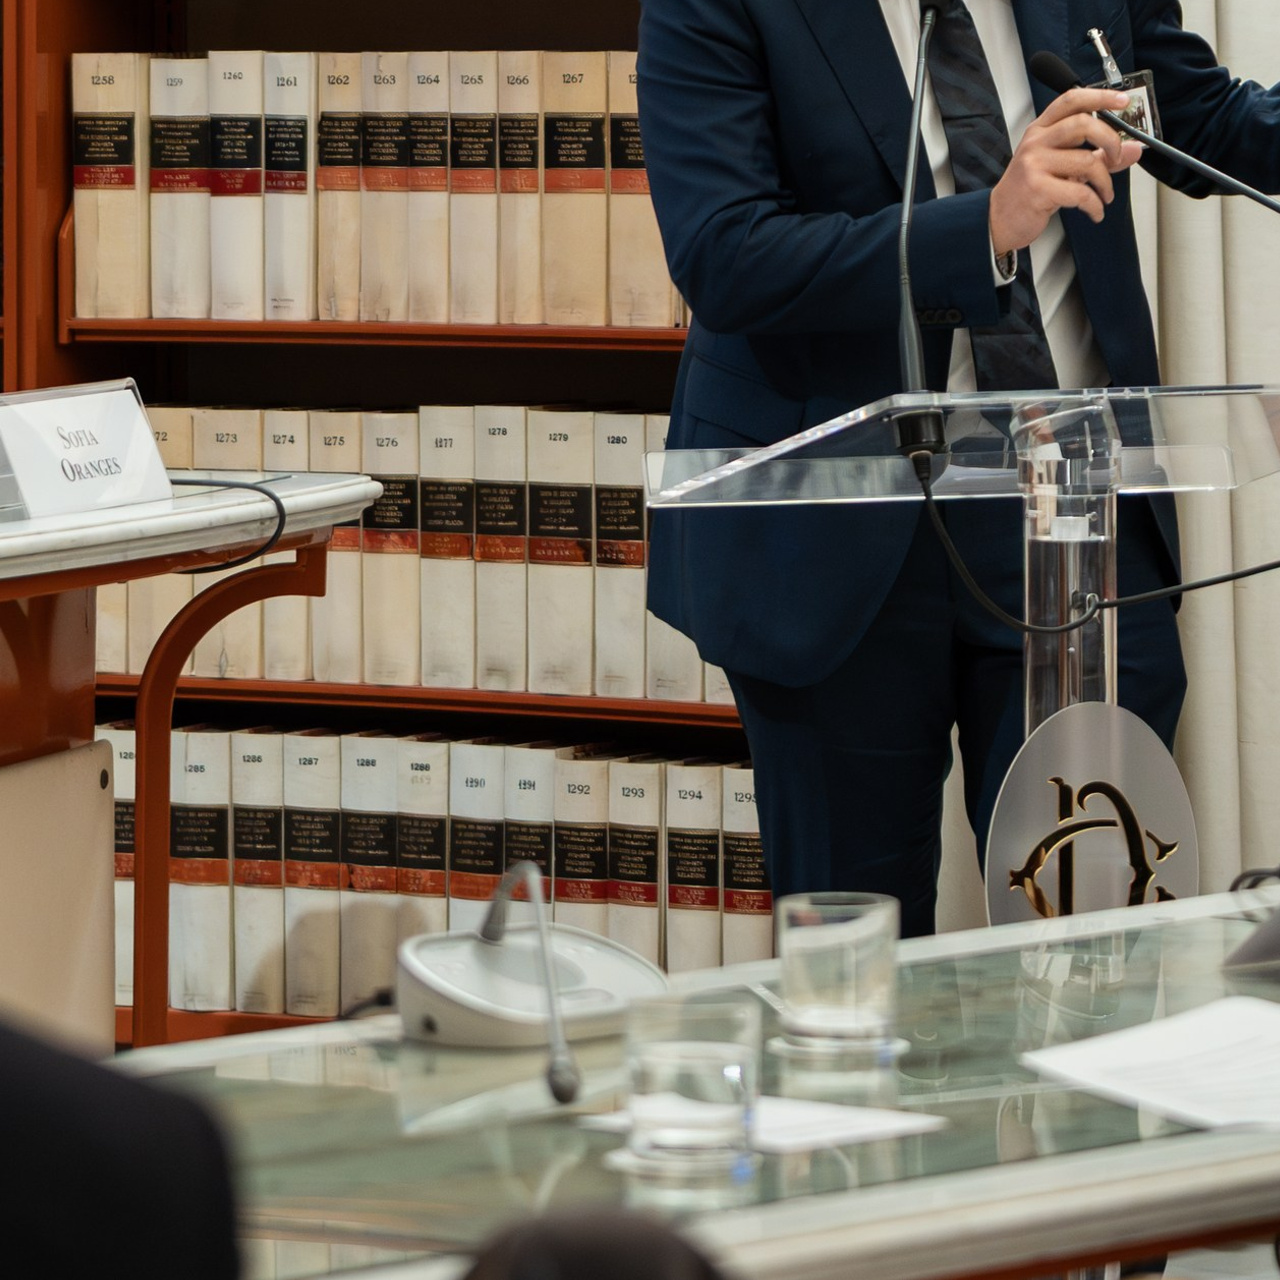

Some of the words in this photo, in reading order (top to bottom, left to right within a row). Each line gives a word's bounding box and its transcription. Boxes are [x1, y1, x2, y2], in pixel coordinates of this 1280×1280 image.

[91, 75, 115, 85] 1258
[223, 71, 243, 80] 1260
[327, 75, 350, 85] 1262
[373, 75, 396, 85] 1263
[417, 75, 440, 84] 1264
[460, 75, 484, 84] 1265
[506, 75, 529, 85] 1266
[562, 73, 584, 83] 1267
[629, 74, 638, 84] 12
[166, 77, 183, 87] 1259
[276, 77, 297, 87] 1261
[488, 427, 507, 436] 1278
[57, 426, 99, 450] SOFIA
[215, 433, 238, 443] 1273
[273, 434, 295, 444] 1274
[323, 436, 345, 446] 1275
[376, 437, 398, 447] 1276
[549, 433, 569, 442] 1279
[607, 436, 627, 444] 1280
[435, 438, 453, 448] 1277
[60, 457, 122, 482] ORANGES
[119, 751, 135, 760] 128
[242, 754, 263, 763] 1286
[298, 757, 319, 766] 1287
[465, 777, 486, 788] 1290
[518, 779, 536, 790] 1291
[567, 784, 590, 795] 1292
[621, 787, 645, 798] 1293
[678, 789, 703, 800] 1294
